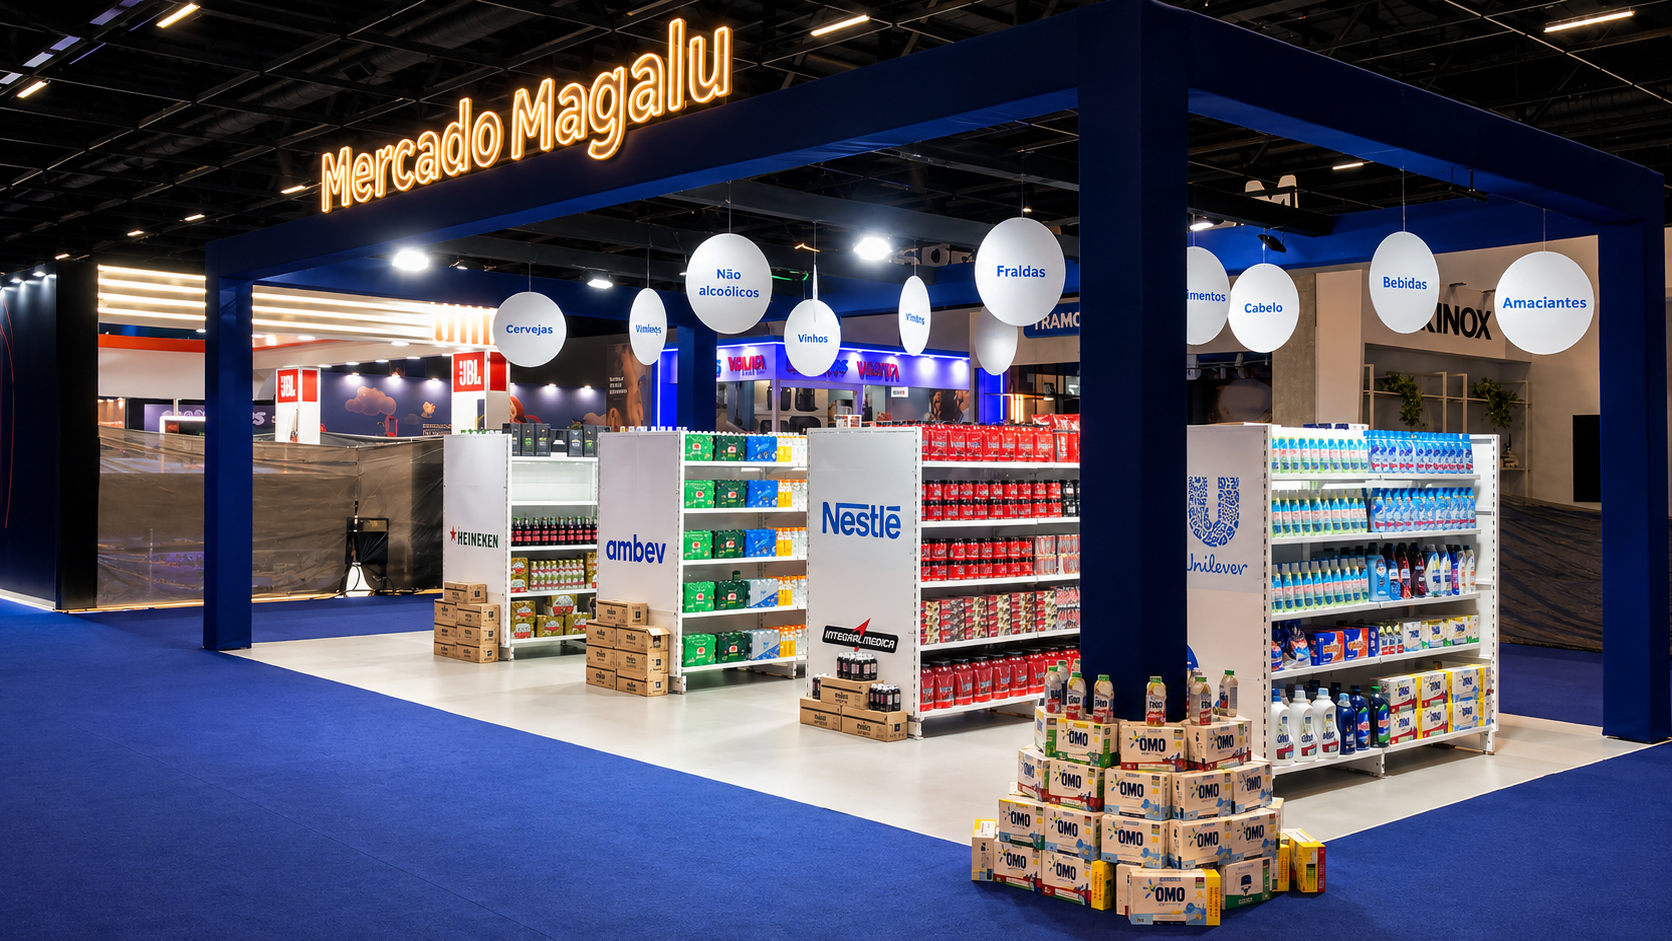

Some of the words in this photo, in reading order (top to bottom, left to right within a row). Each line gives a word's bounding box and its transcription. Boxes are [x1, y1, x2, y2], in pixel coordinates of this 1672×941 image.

[321, 97, 503, 213] Mercado
[511, 18, 733, 160] Magalu
[717, 268, 742, 280] Não
[997, 265, 1046, 278] Fraldas
[1383, 276, 1427, 291] Bebidas
[1244, 302, 1283, 313] Cabelo
[1502, 296, 1587, 310] Amaciantes
[505, 324, 553, 337] Cervejas
[798, 334, 828, 344] Vinhos
[459, 359, 482, 386] JBL
[822, 501, 901, 540] Nestlé
[457, 531, 499, 549] HEINEKEN
[606, 534, 667, 564] ambev
[1068, 730, 1088, 747] OMO
[1139, 738, 1166, 752] OMO
[1217, 734, 1234, 750] OMO
[1061, 772, 1082, 789] OMO
[1119, 781, 1144, 798] OMO
[1198, 783, 1219, 799] OMO
[1010, 810, 1031, 828] OMO
[1057, 819, 1078, 837] OMO
[1245, 824, 1265, 841] OMO
[1118, 829, 1144, 846] OMO
[1197, 831, 1219, 848] OMO
[1006, 852, 1027, 869] OMO
[1056, 862, 1077, 880] OMO
[1155, 887, 1186, 902] OMO
